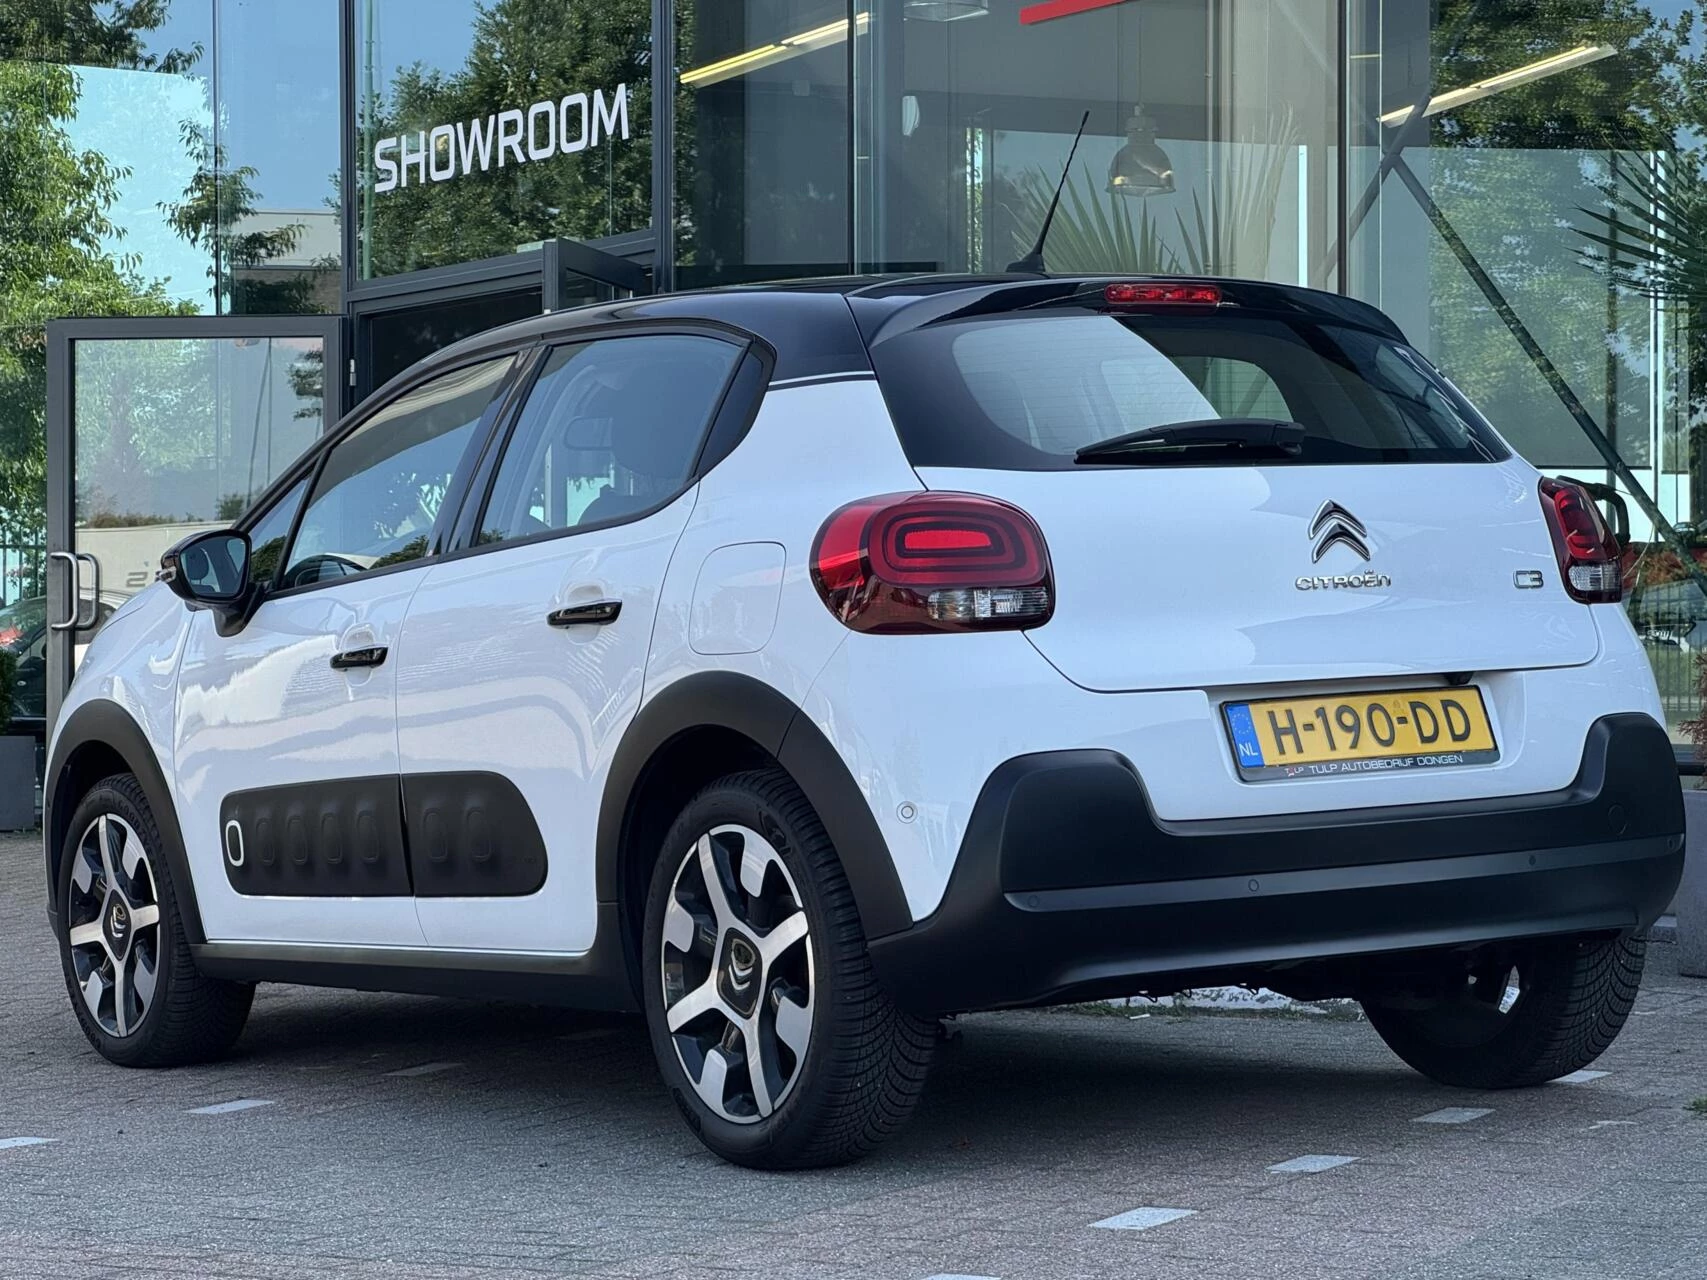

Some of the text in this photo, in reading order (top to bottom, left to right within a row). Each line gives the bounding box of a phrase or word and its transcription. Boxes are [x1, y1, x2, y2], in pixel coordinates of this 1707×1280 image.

[374, 82, 630, 193] SHOWROOM
[1295, 569, 1392, 591] CITROËN
[1513, 570, 1544, 590] C3
[1266, 698, 1471, 756] H-190-DD
[1239, 742, 1259, 758] NL
[1309, 754, 1463, 775] TULP AUTOBEDRIJF DONGEN
